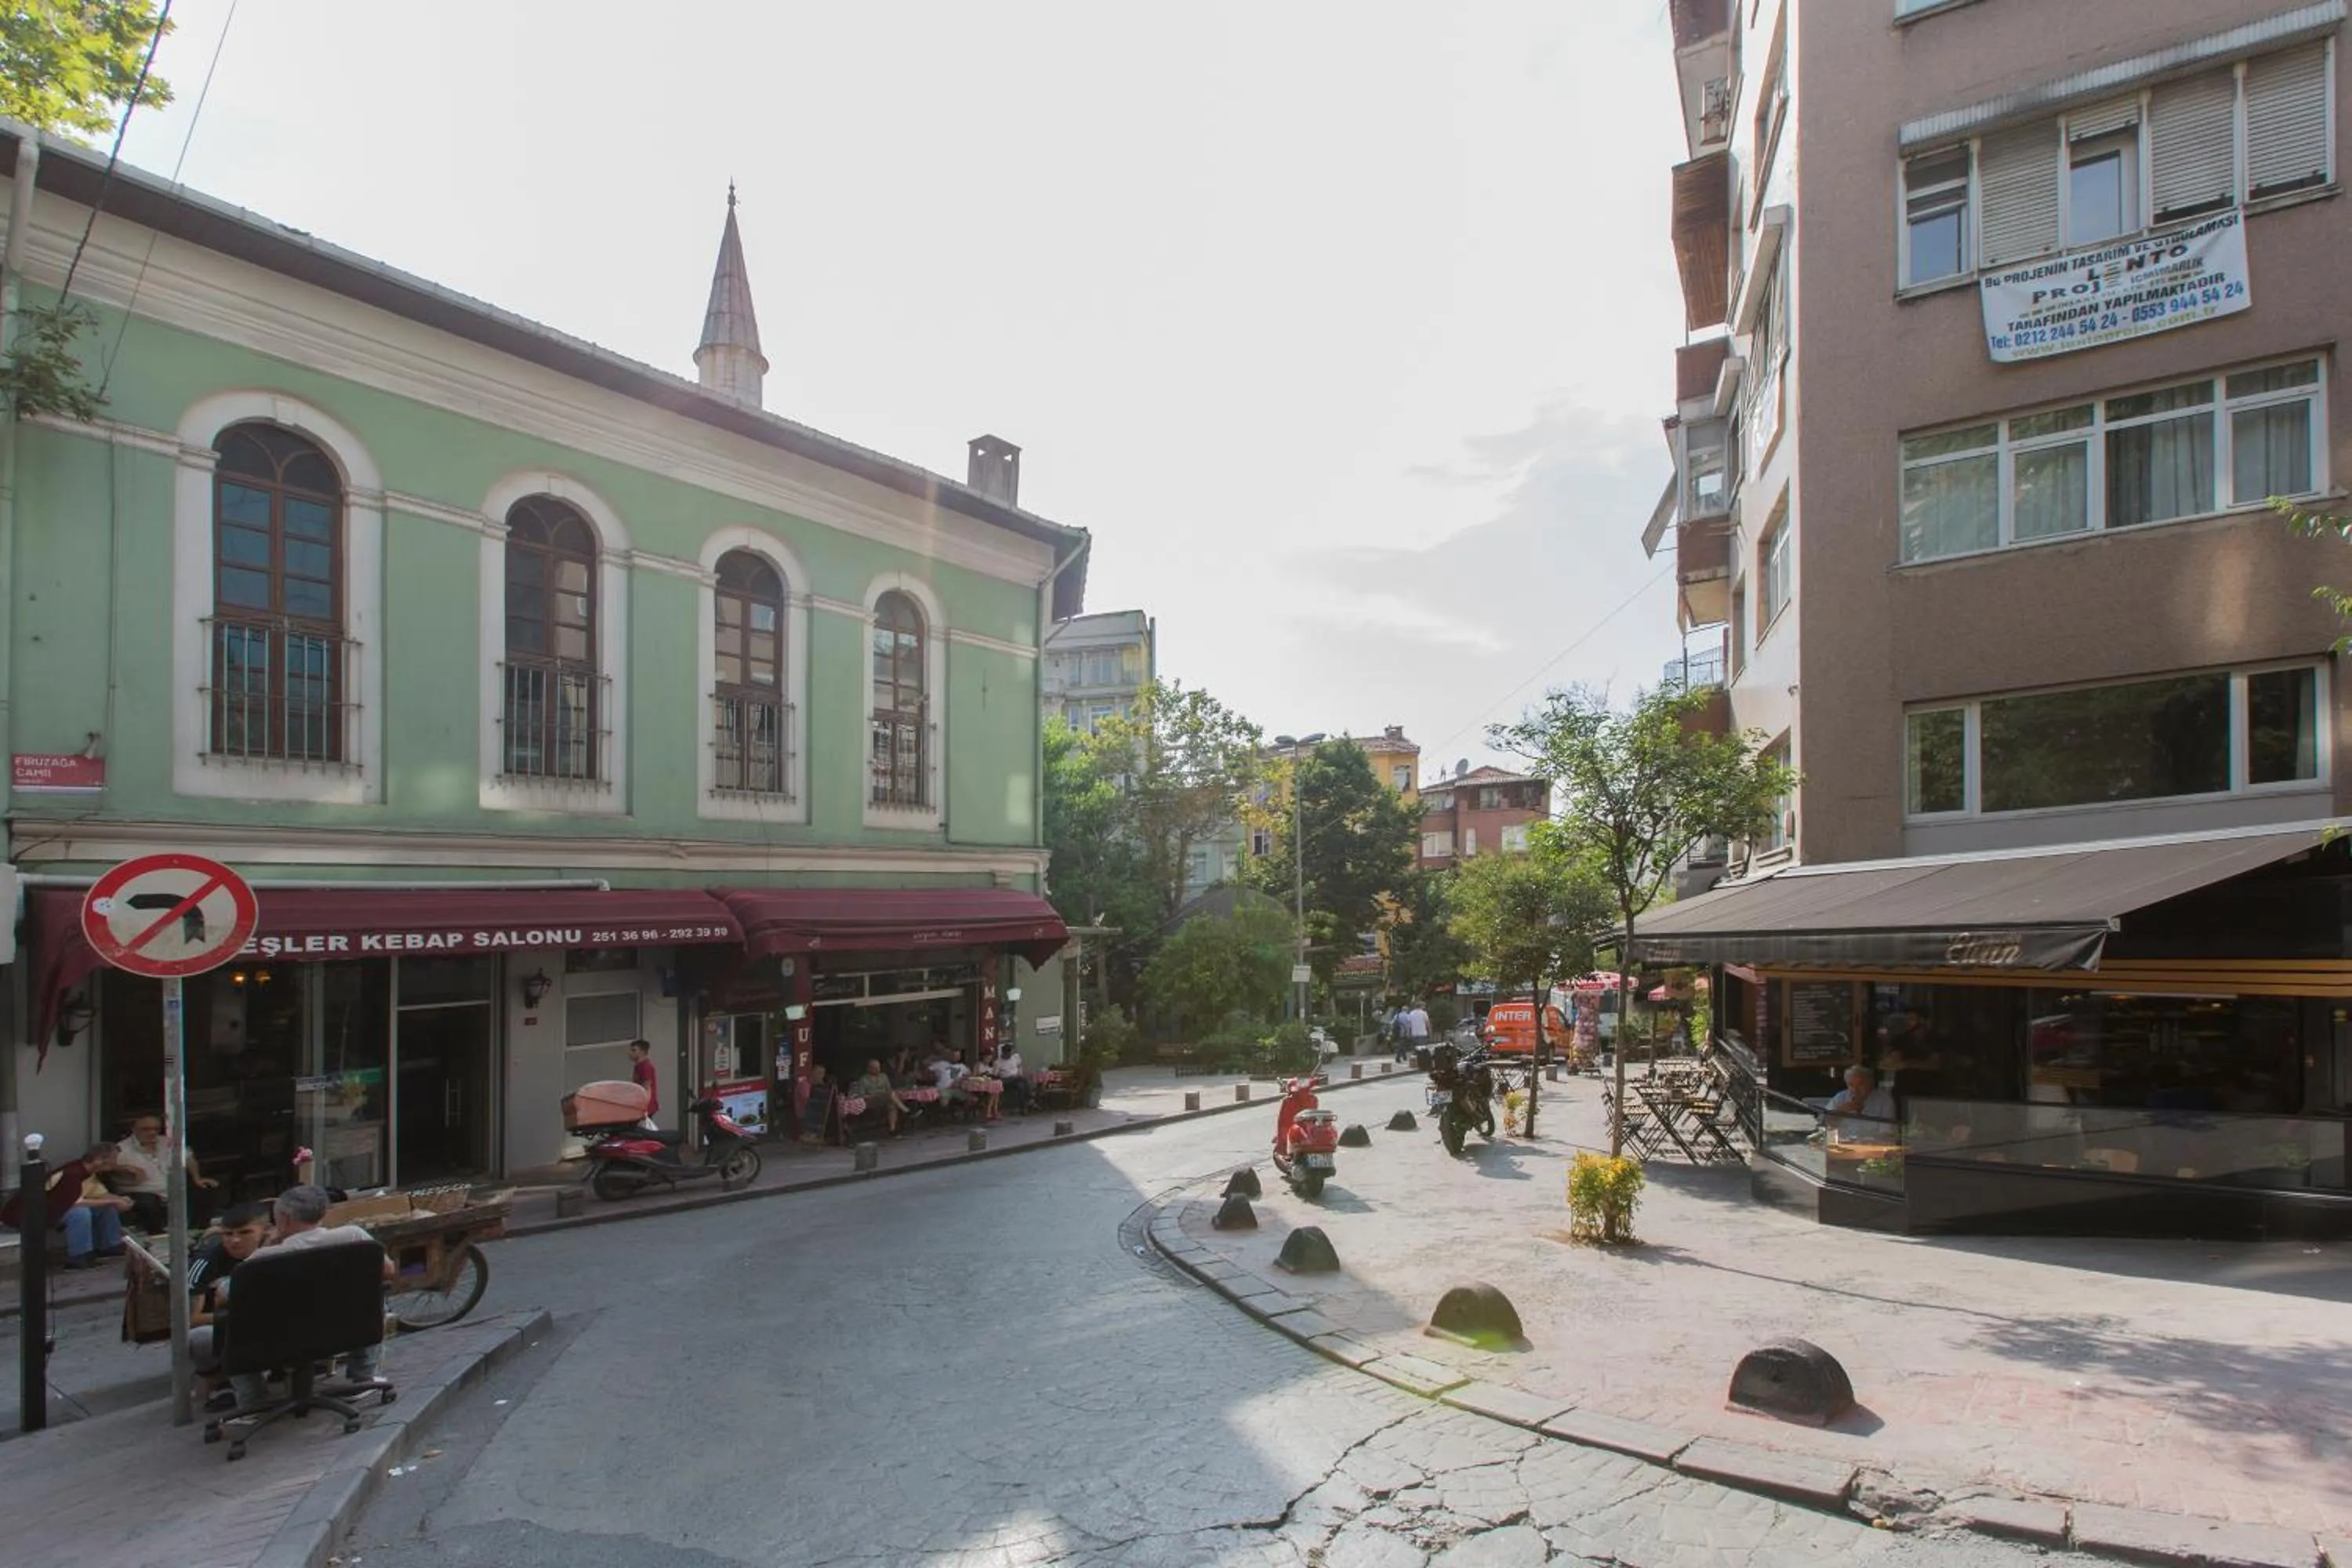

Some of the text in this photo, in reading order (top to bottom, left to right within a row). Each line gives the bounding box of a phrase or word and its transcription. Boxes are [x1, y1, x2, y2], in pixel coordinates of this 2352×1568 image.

[2072, 245, 2130, 270] TASARIM
[1991, 336, 2011, 349] Tel:
[2014, 329, 2047, 347] 0212
[2049, 322, 2075, 340] 244
[2079, 316, 2096, 334] 54
[2100, 312, 2118, 330] 24
[2132, 303, 2165, 322] 0553
[2170, 293, 2198, 312] 944
[2202, 288, 2220, 304] 54
[2225, 280, 2244, 299] 24
[2007, 302, 2099, 332] TARAFINDAN
[2105, 272, 2225, 310] YAPILMAKTADIR
[361, 933, 463, 950] KEBAP
[473, 930, 581, 946] SALONU
[593, 931, 617, 942] 251
[622, 931, 639, 941] 36
[1495, 1011, 1532, 1021] INTER
